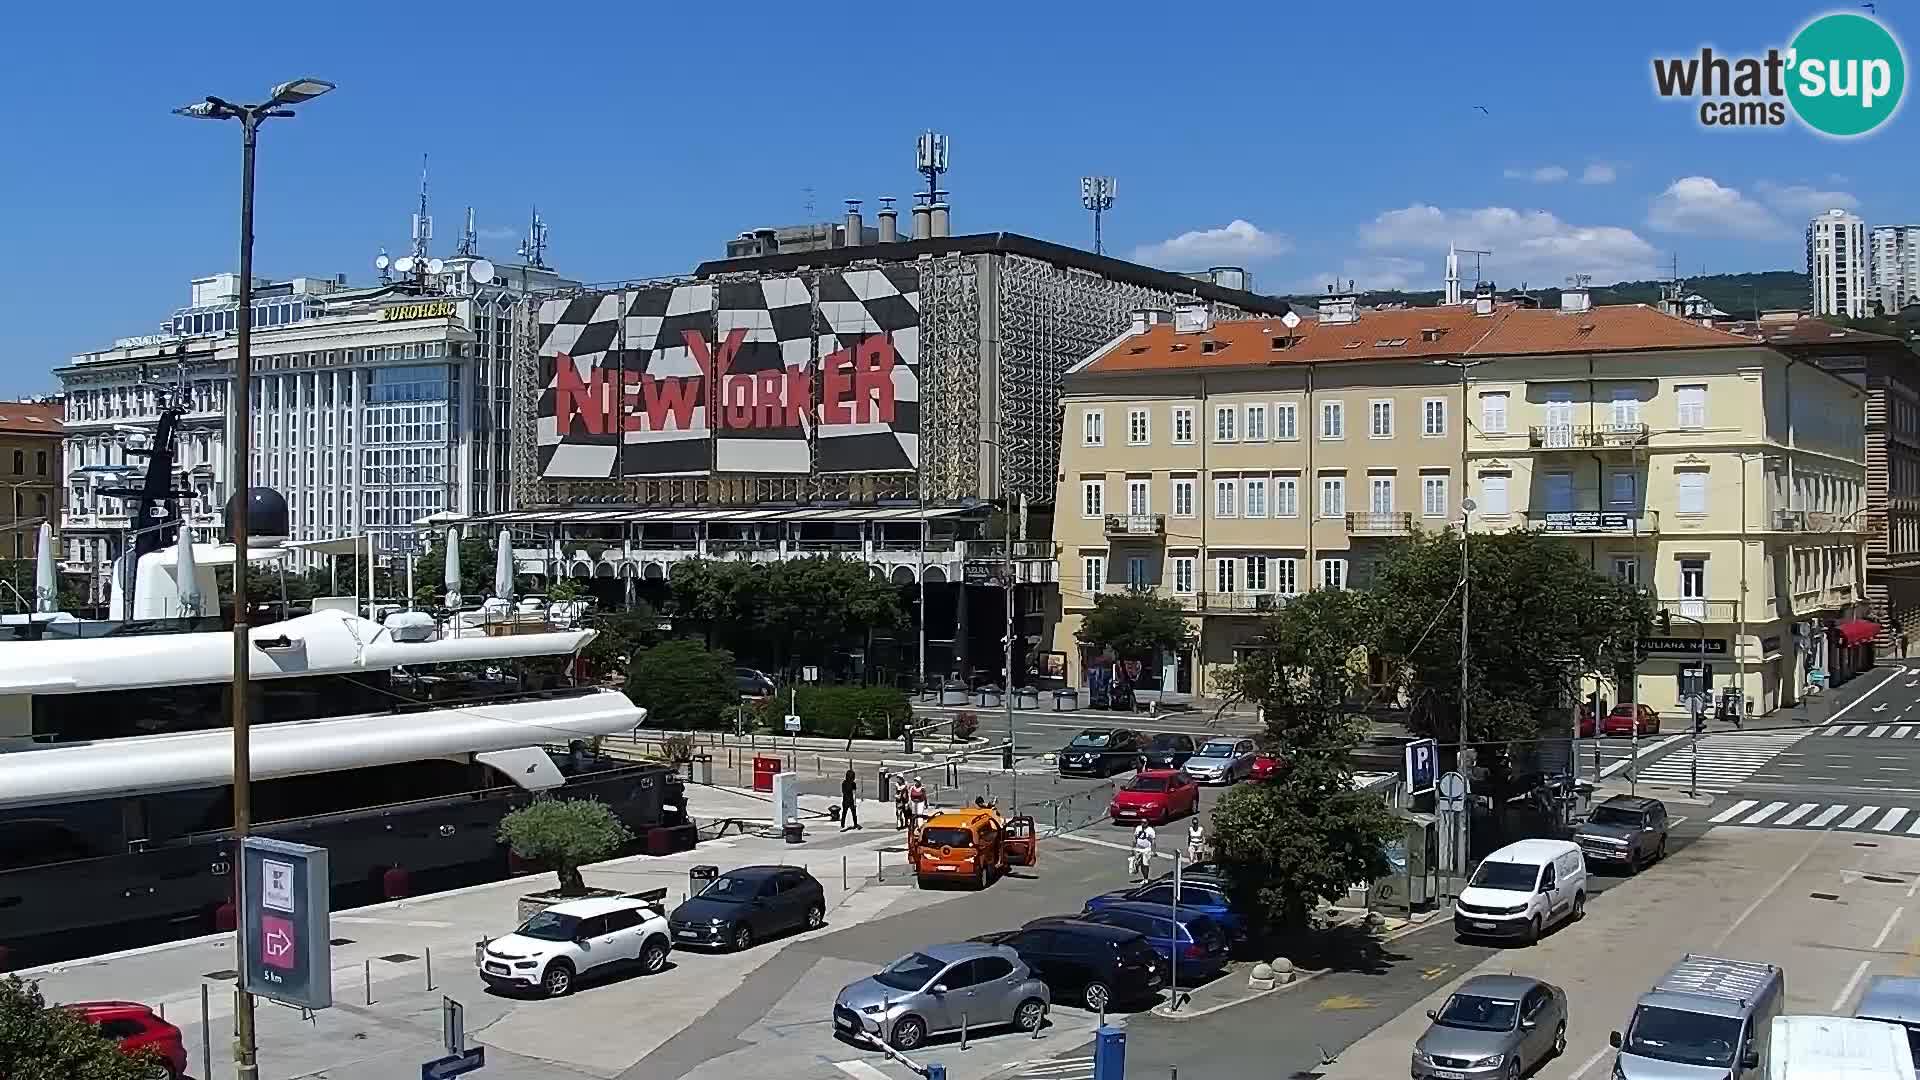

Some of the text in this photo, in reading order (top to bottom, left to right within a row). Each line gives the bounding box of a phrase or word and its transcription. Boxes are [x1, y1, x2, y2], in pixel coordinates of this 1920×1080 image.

[1416, 746, 1429, 770] P
[264, 970, 283, 984] 5 km
